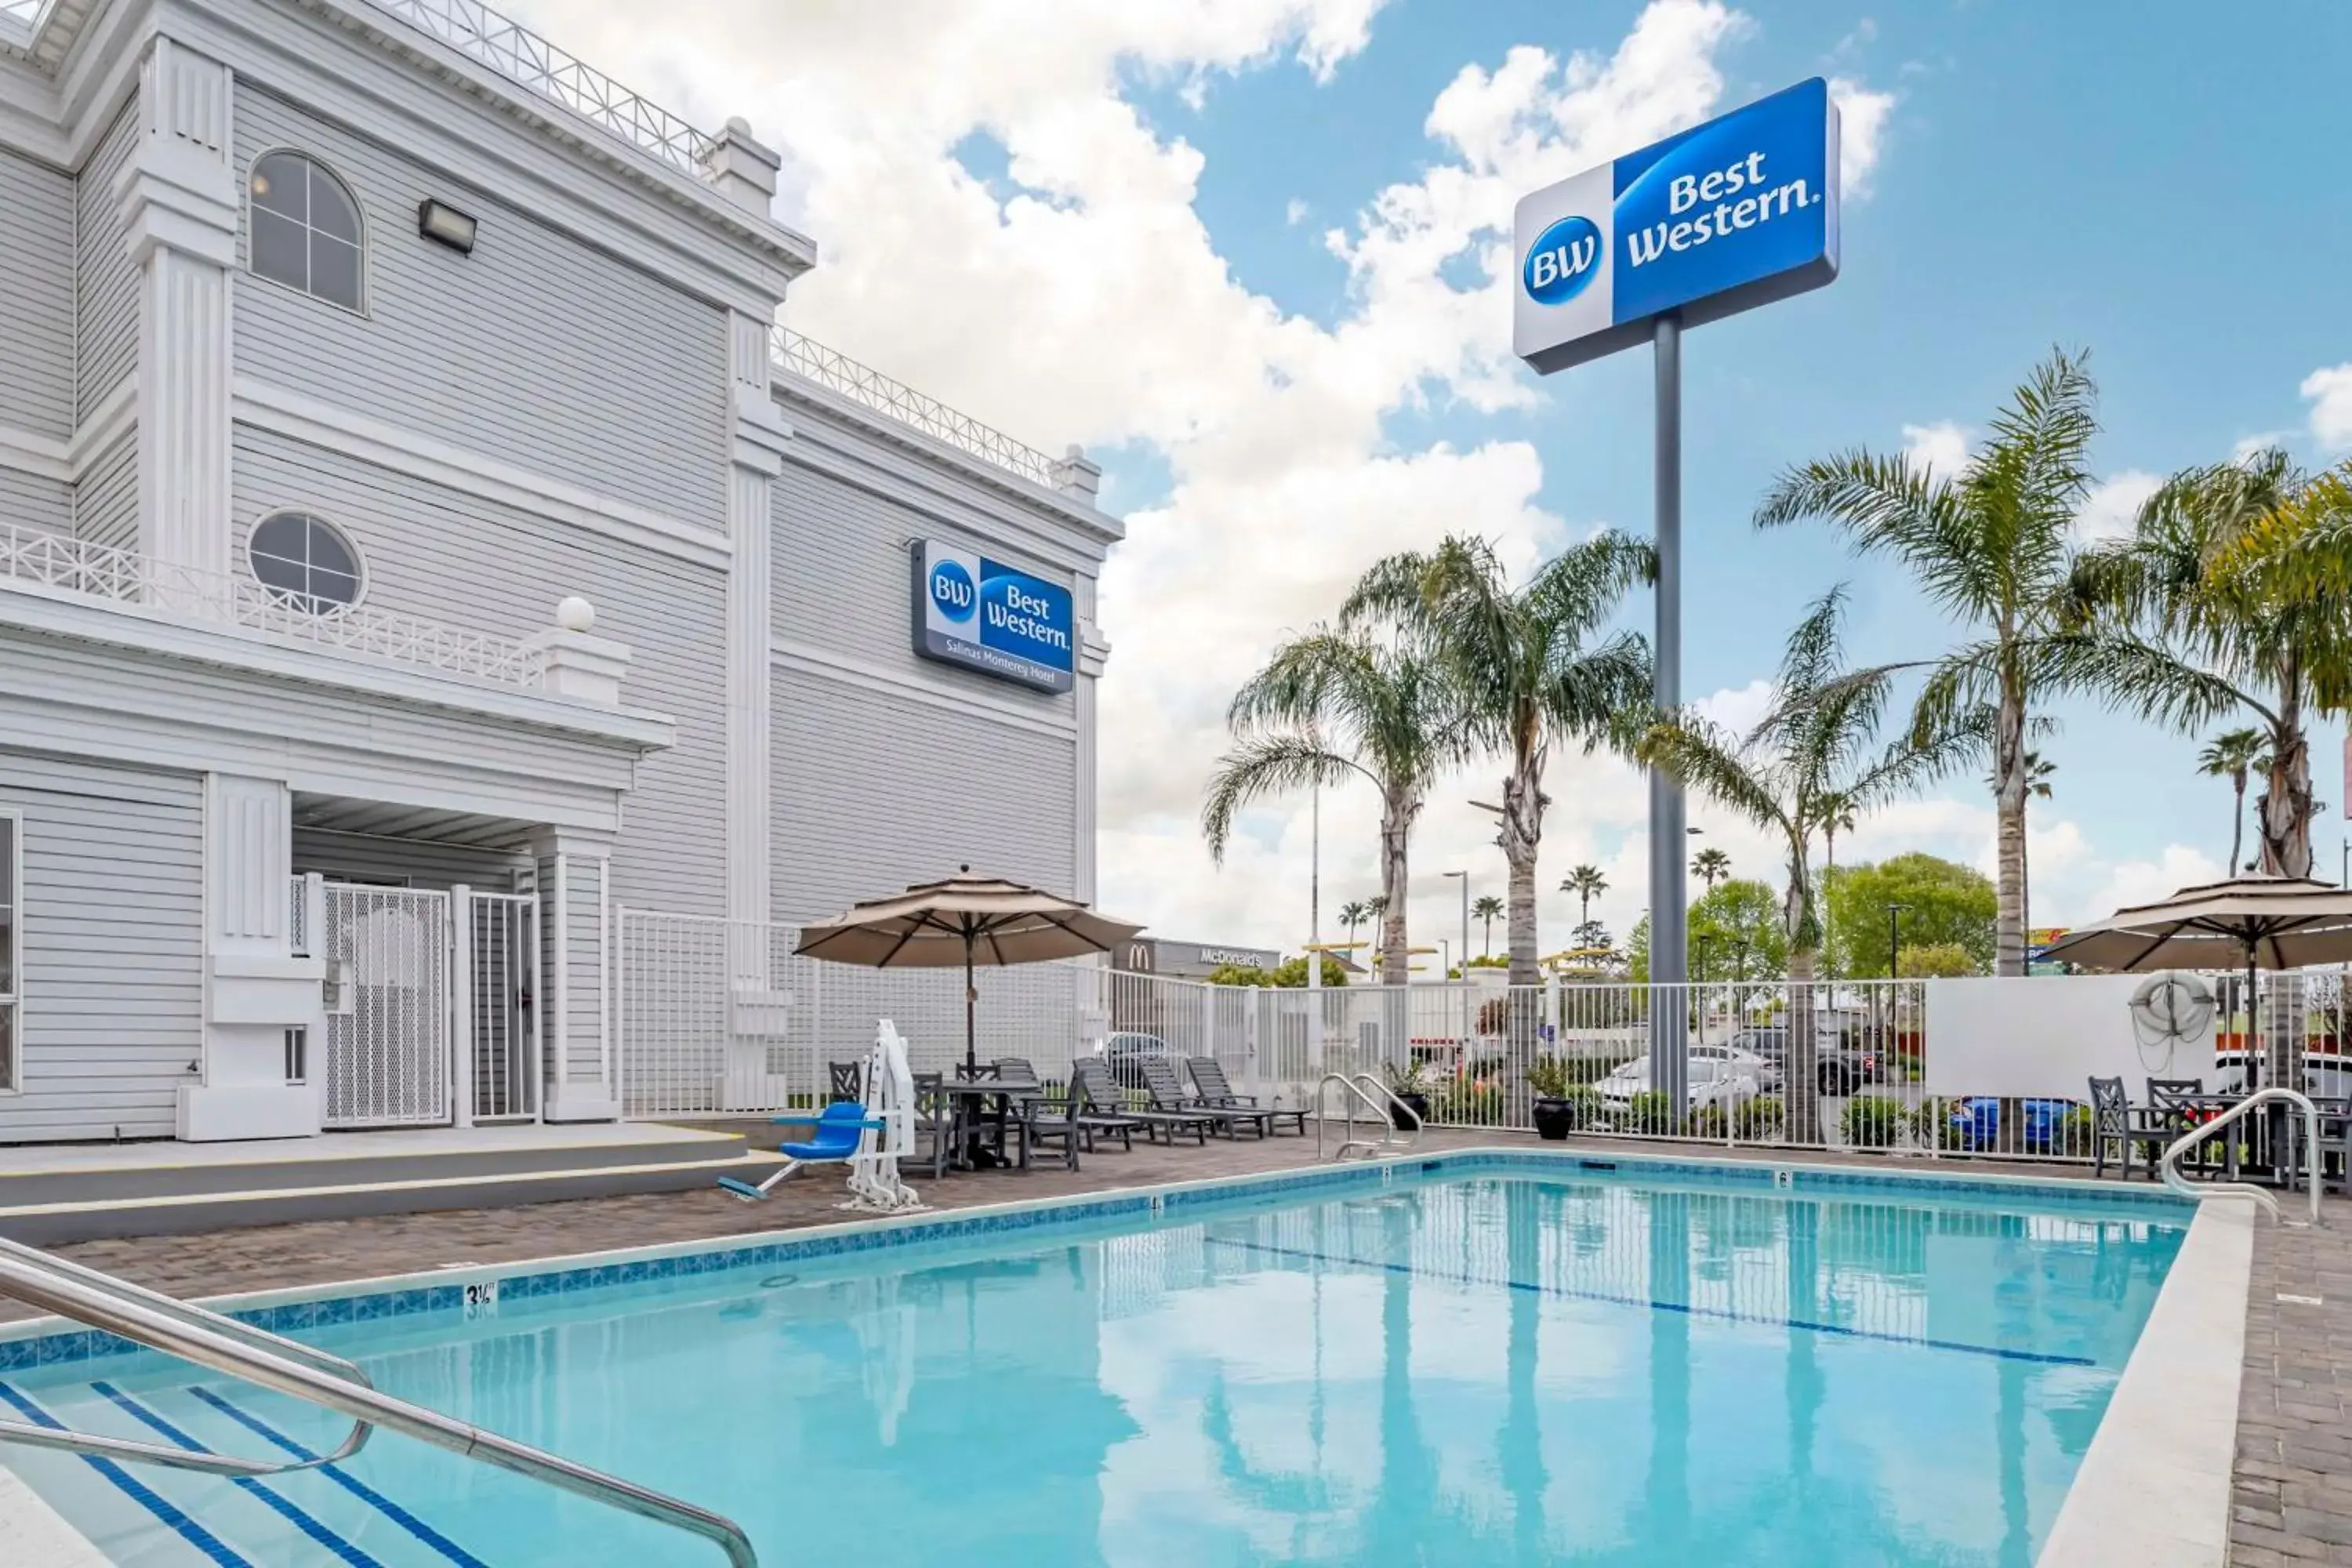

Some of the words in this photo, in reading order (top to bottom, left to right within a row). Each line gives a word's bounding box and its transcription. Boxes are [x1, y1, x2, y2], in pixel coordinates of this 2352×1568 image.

[1670, 151, 1766, 215] Best
[1534, 235, 1595, 289] BW
[935, 575, 971, 608] BW
[1007, 584, 1049, 619] Best
[946, 639, 981, 659] Salinas
[984, 652, 1028, 677] Monterey
[1030, 666, 1054, 683] Hotel
